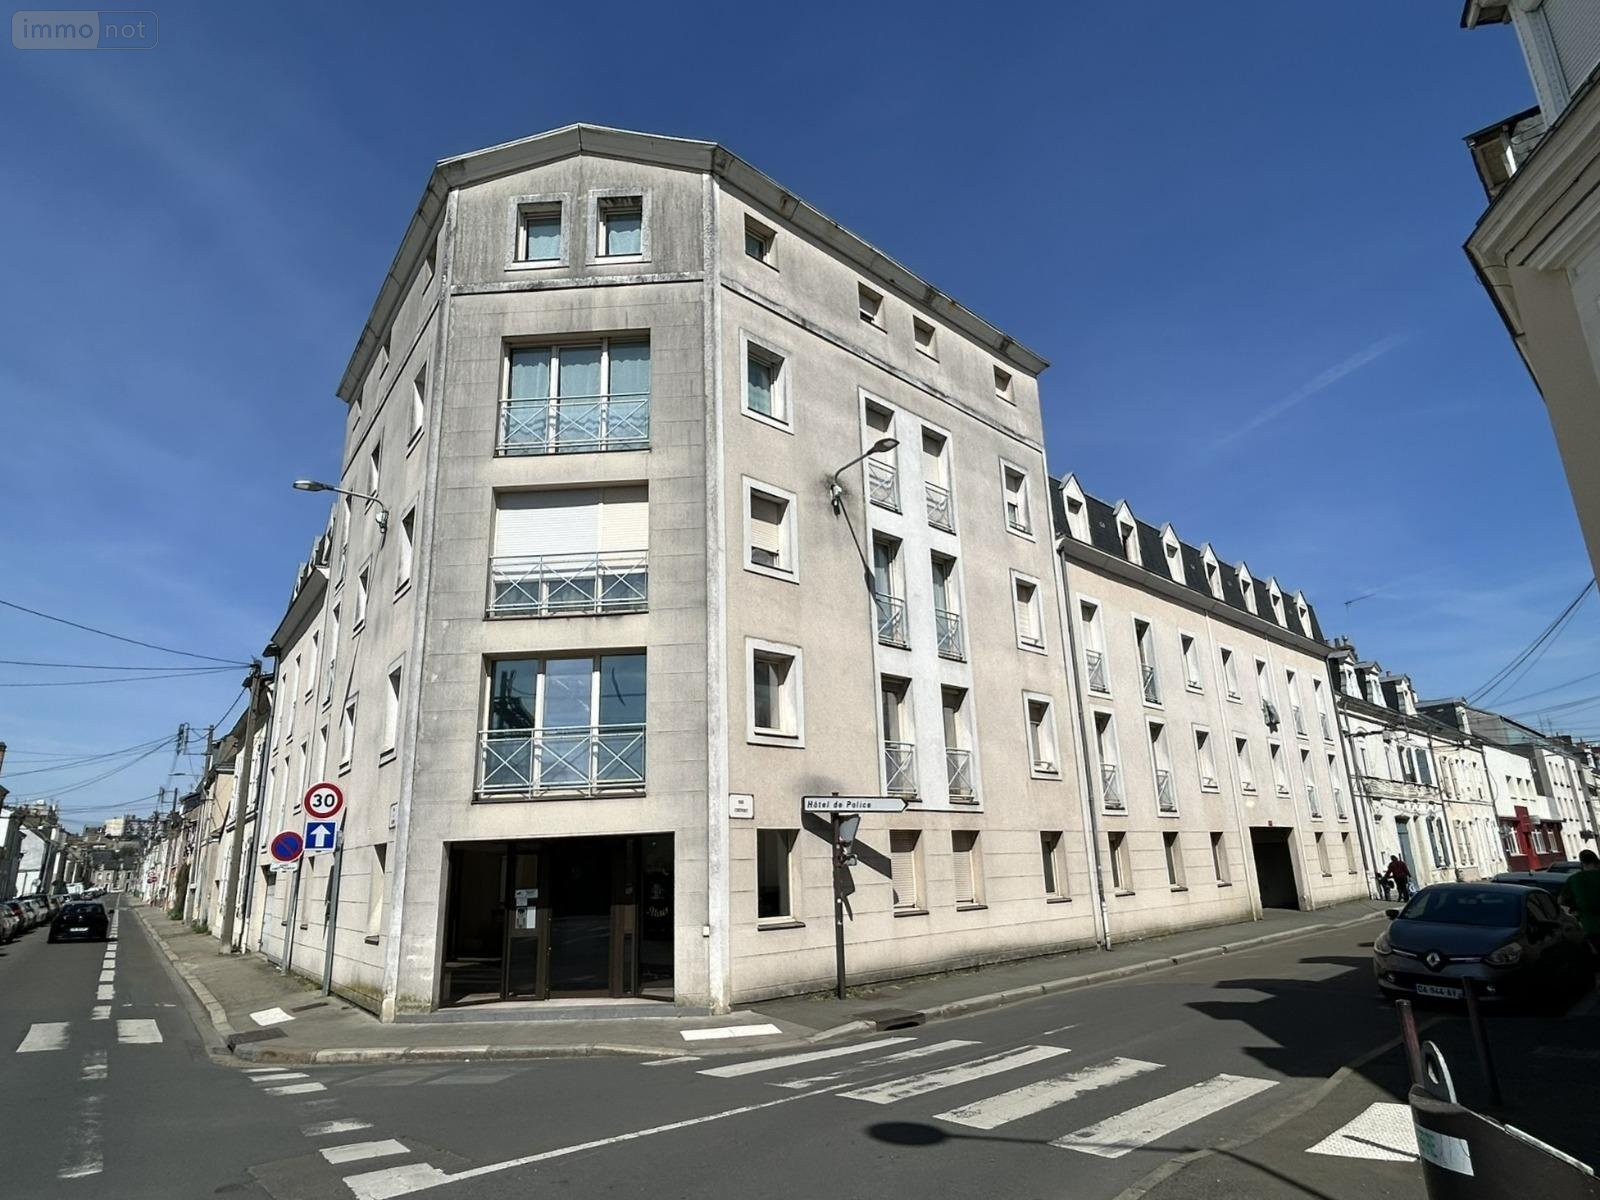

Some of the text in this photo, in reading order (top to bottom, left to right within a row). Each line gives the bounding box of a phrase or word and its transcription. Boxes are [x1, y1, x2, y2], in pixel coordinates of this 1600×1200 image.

[312, 793, 335, 808] 30
[806, 800, 872, 808] Hôtel de Police
